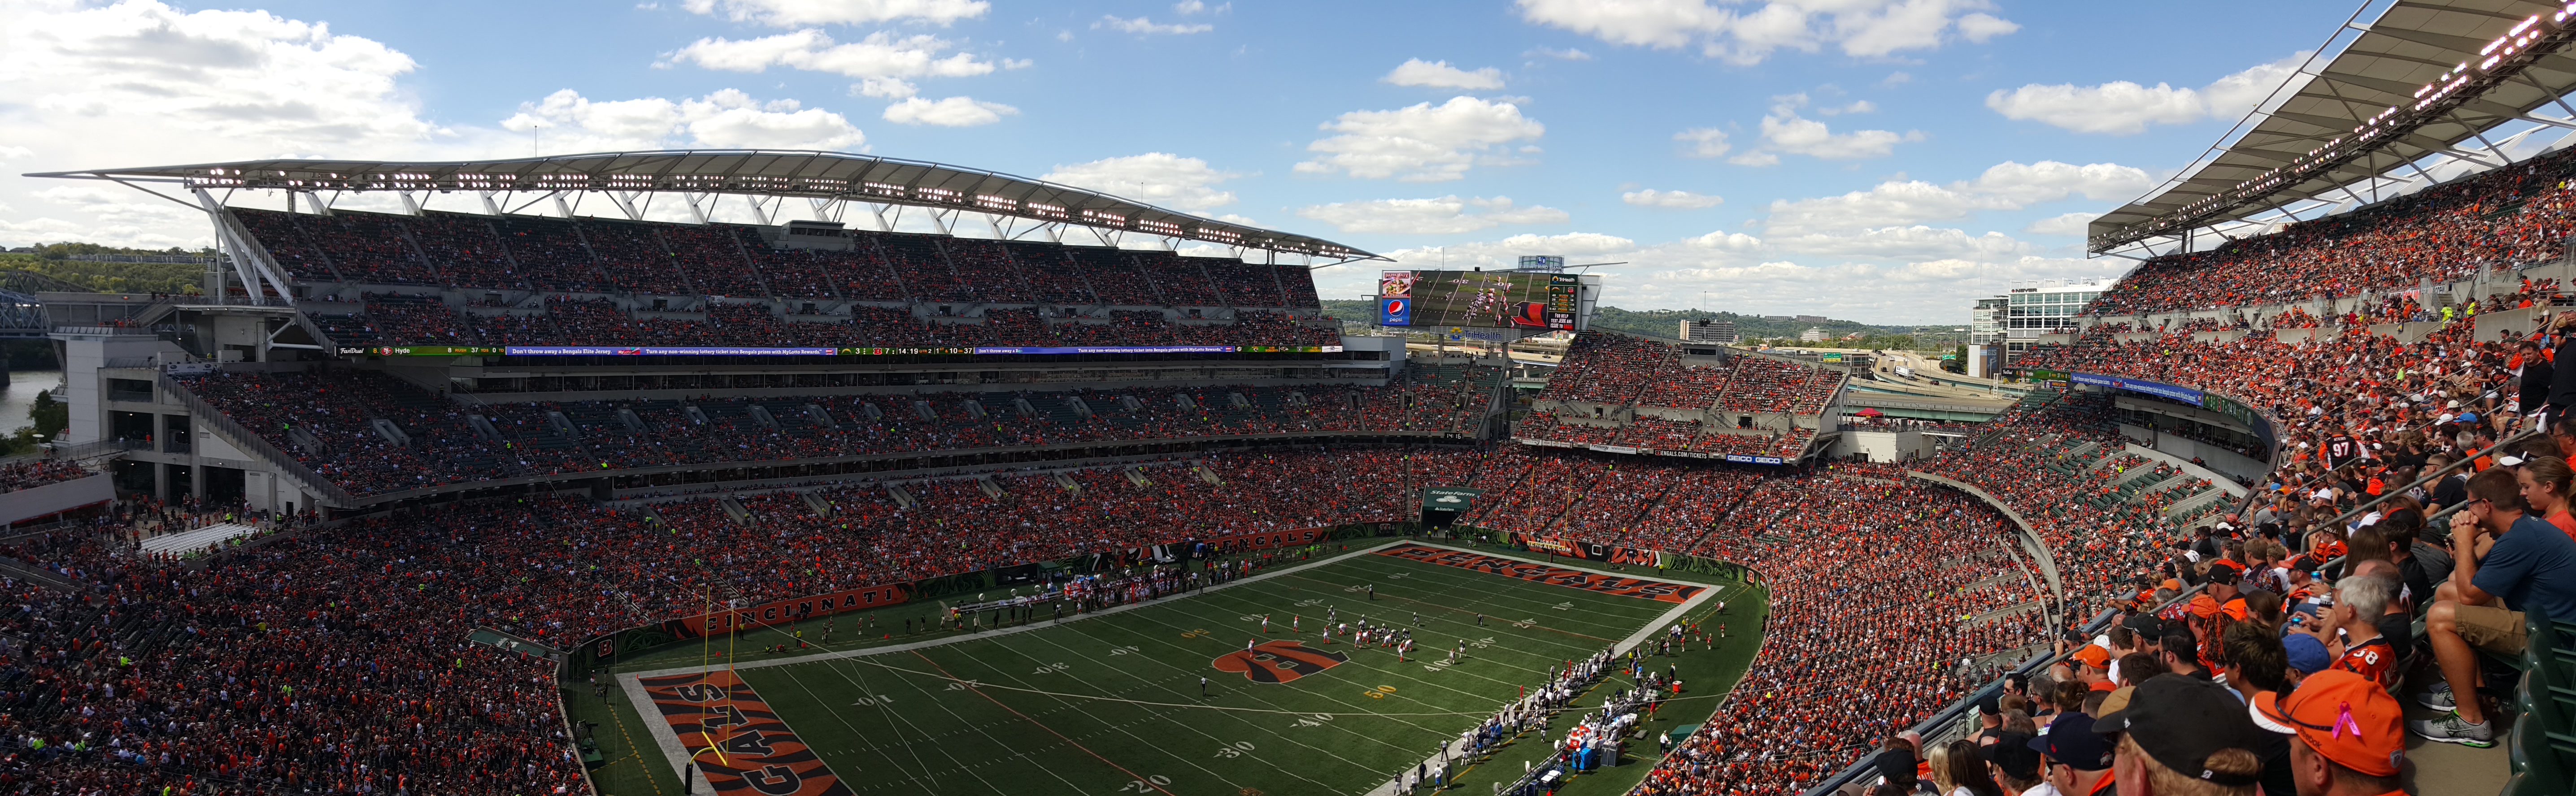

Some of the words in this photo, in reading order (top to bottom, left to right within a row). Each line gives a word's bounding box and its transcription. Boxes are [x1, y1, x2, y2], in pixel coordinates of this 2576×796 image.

[1464, 330, 1501, 339] TriHealth
[2133, 384, 2145, 392] non-winning
[2222, 400, 2225, 412] 7
[1655, 450, 1707, 459] BENGALS.COM/TICKETS
[2333, 442, 2349, 457] 97
[1206, 531, 1314, 550] BENGALS
[1401, 548, 1677, 595] BENGALS
[704, 588, 892, 631] CINCINNATI
[1424, 659, 1451, 672] 40
[1364, 684, 1397, 699] 50
[1299, 713, 1333, 727] 40
[2299, 726, 2322, 749] Reebok
[1218, 741, 1255, 758] 30
[1127, 774, 1171, 794] 20
